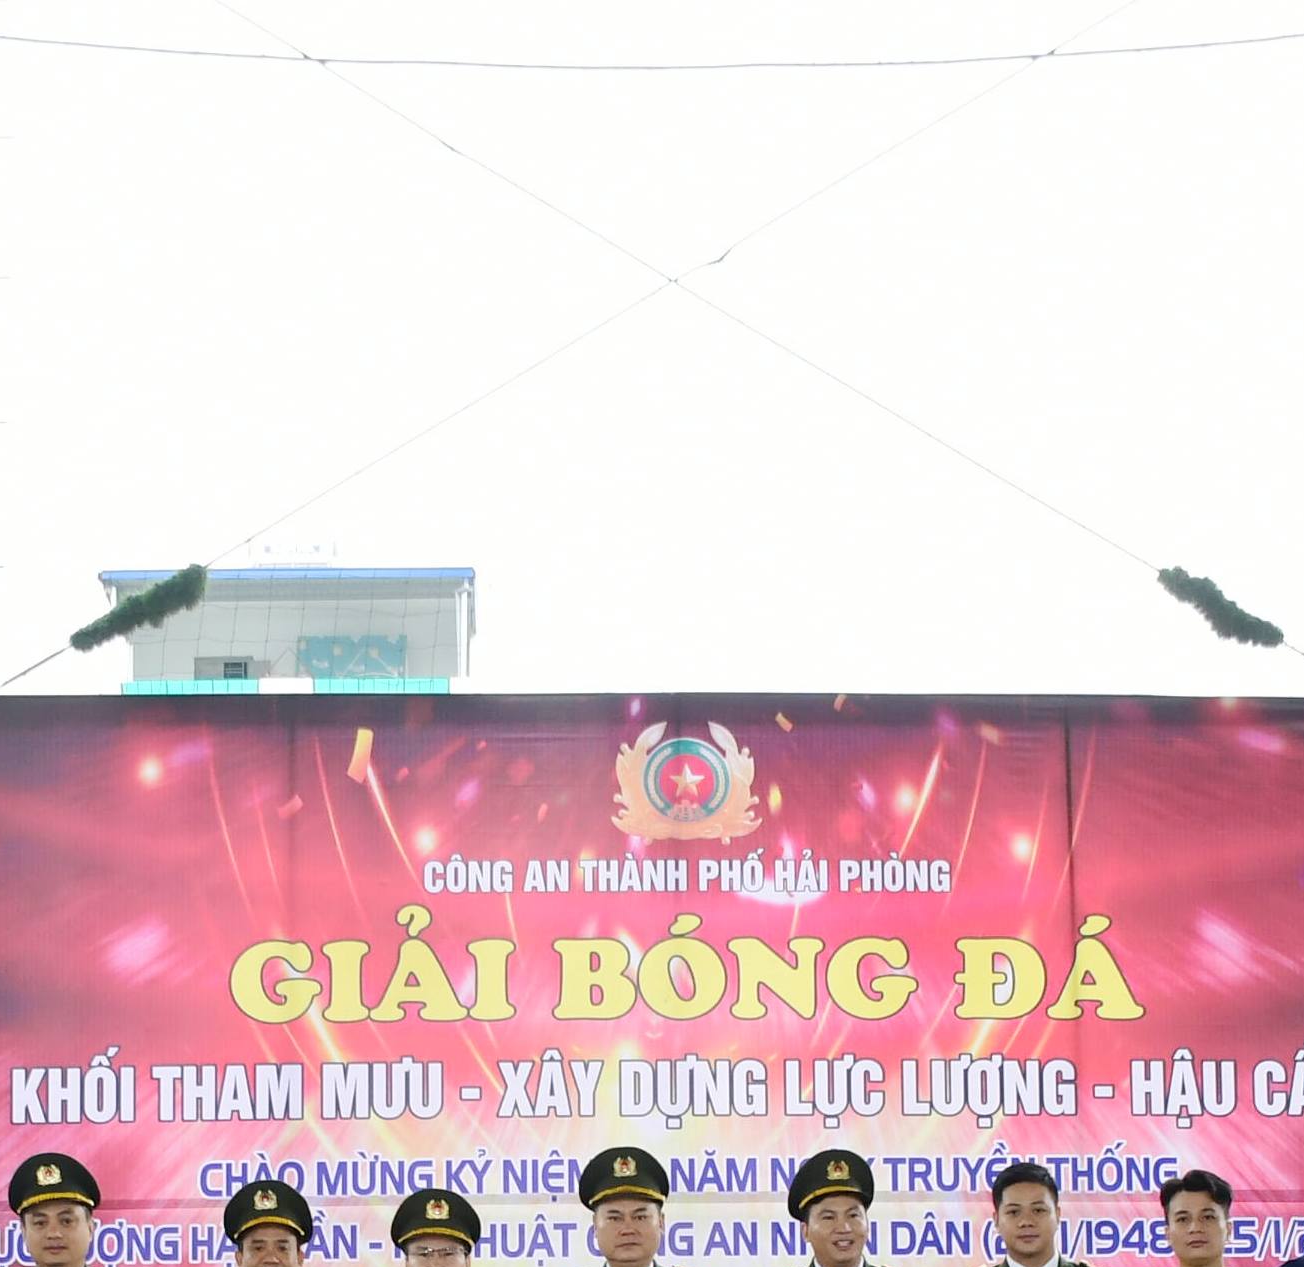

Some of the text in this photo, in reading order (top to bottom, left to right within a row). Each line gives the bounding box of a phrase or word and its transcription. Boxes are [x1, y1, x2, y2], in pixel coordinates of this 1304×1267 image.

[423, 848, 951, 894] CÔNG AN THÀNH PHỐ HẢI PHÒNG
[228, 904, 1146, 1025] GIẢI BÓNG ĐÁ
[10, 1045, 136, 1125] KHỐI
[151, 1062, 305, 1123] THAM
[322, 1054, 443, 1121] MƯU
[497, 1047, 604, 1119] XÂY
[619, 1050, 769, 1130] DỰNG
[784, 1051, 886, 1129] LỰC
[901, 1050, 1077, 1129] LƯỢNG
[1130, 1048, 1238, 1129] HẬU
[316, 1151, 434, 1196] MỪNG
[446, 1149, 493, 1194] KỶ
[670, 1150, 757, 1192] NĂM
[1046, 1140, 1178, 1192] THỐNG
[305, 1211, 358, 1259] ẦN
[475, 1214, 577, 1267] HUẬT
[703, 1221, 758, 1256] AN
[891, 1212, 970, 1256] DÂN
